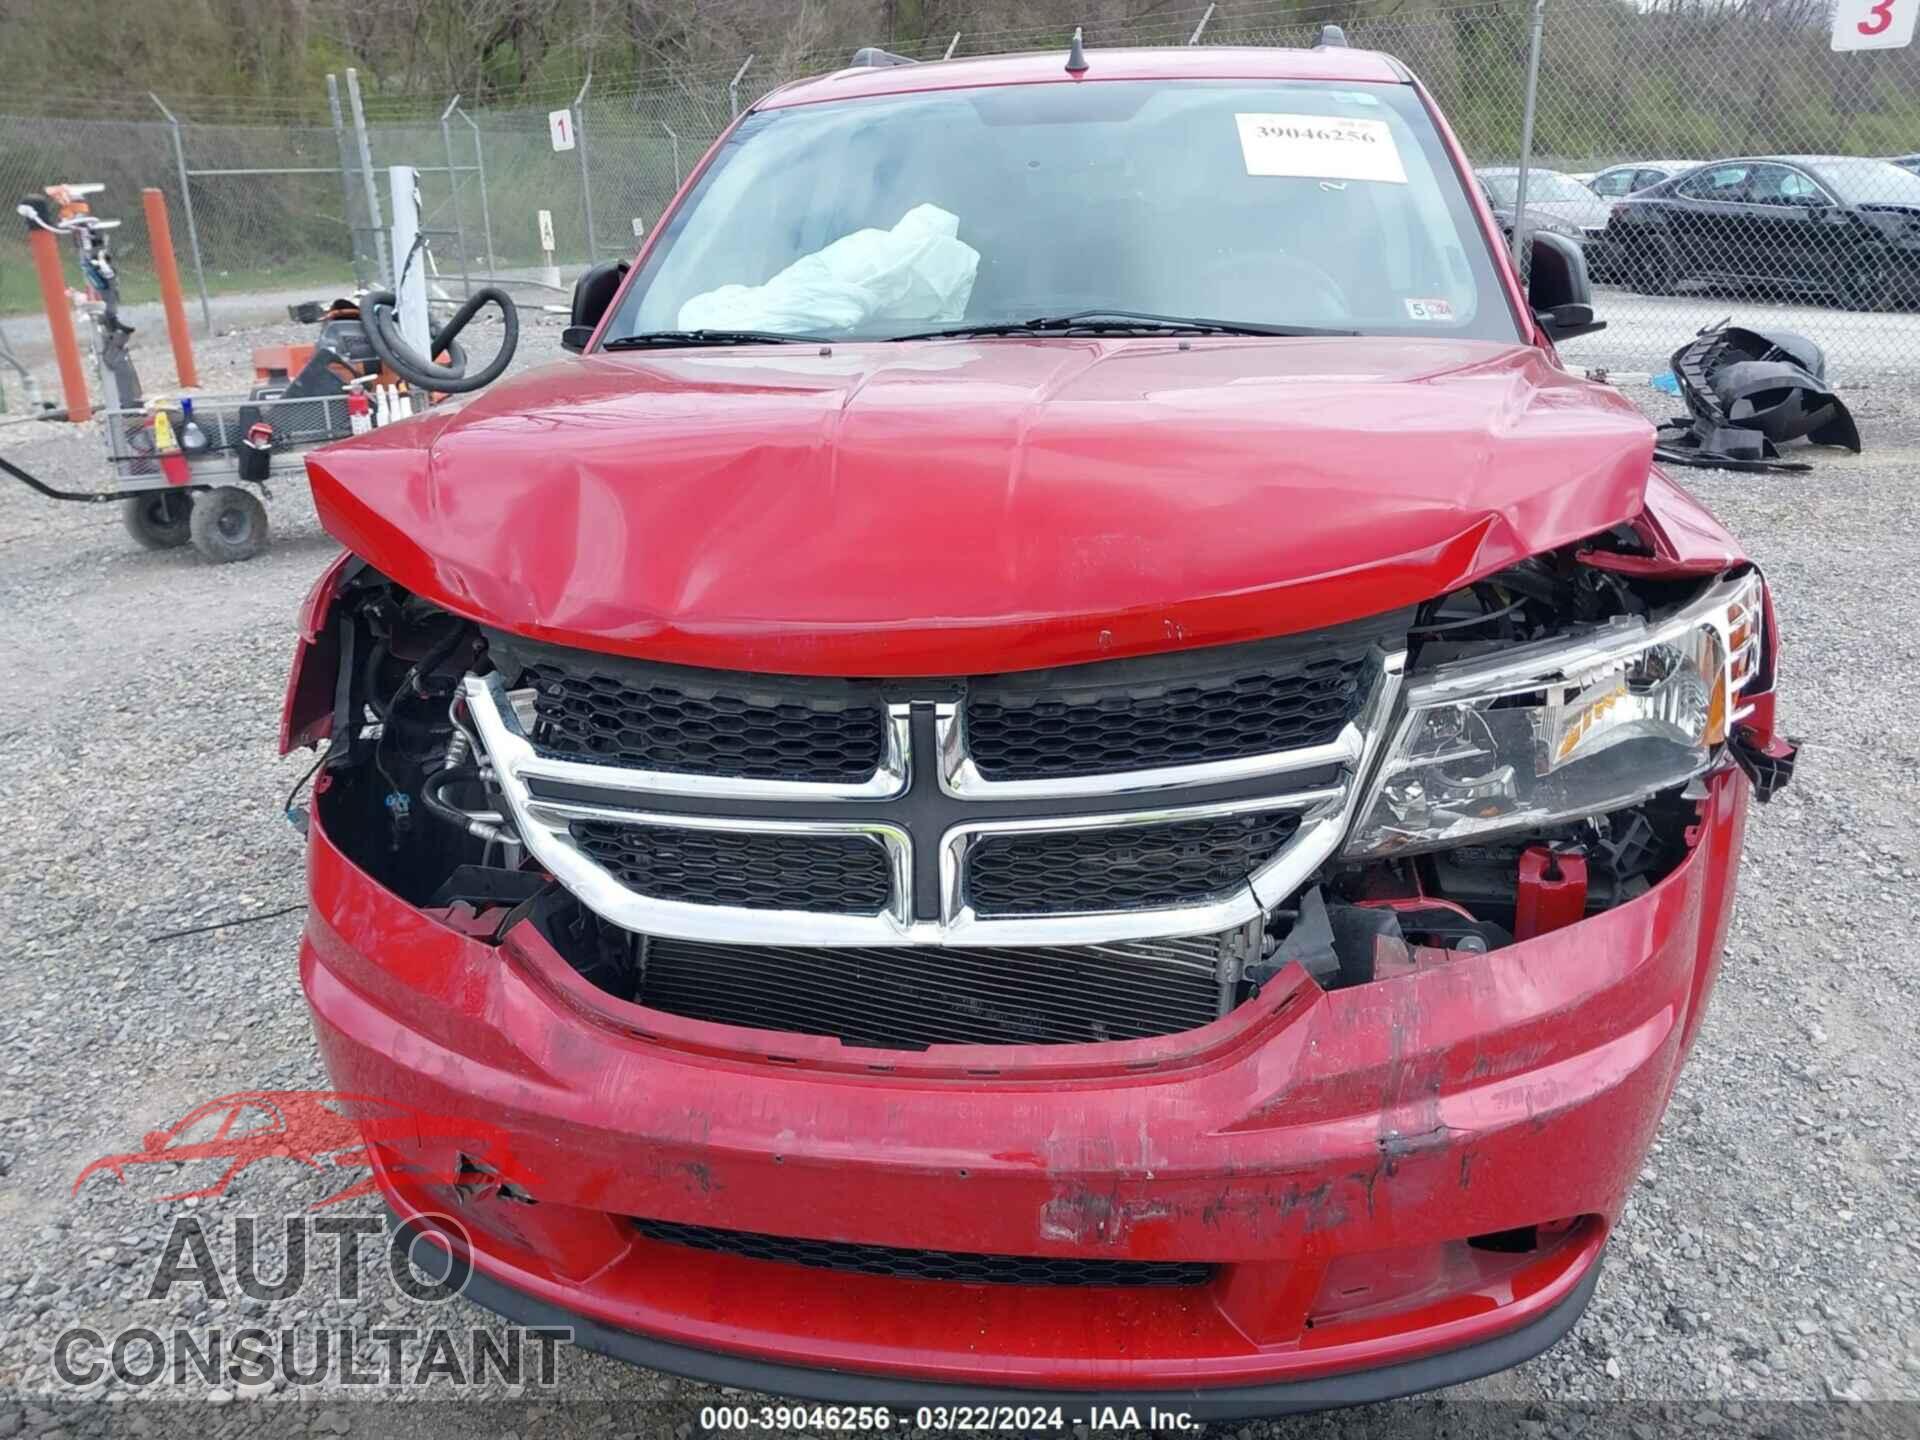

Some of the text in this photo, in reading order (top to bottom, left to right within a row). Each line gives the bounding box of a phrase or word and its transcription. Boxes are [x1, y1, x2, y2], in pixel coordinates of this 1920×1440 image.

[1856, 0, 1897, 36] 3
[557, 117, 567, 143] 1
[1256, 125, 1376, 144] 39046256
[543, 220, 554, 241] A
[1412, 303, 1425, 316] 5
